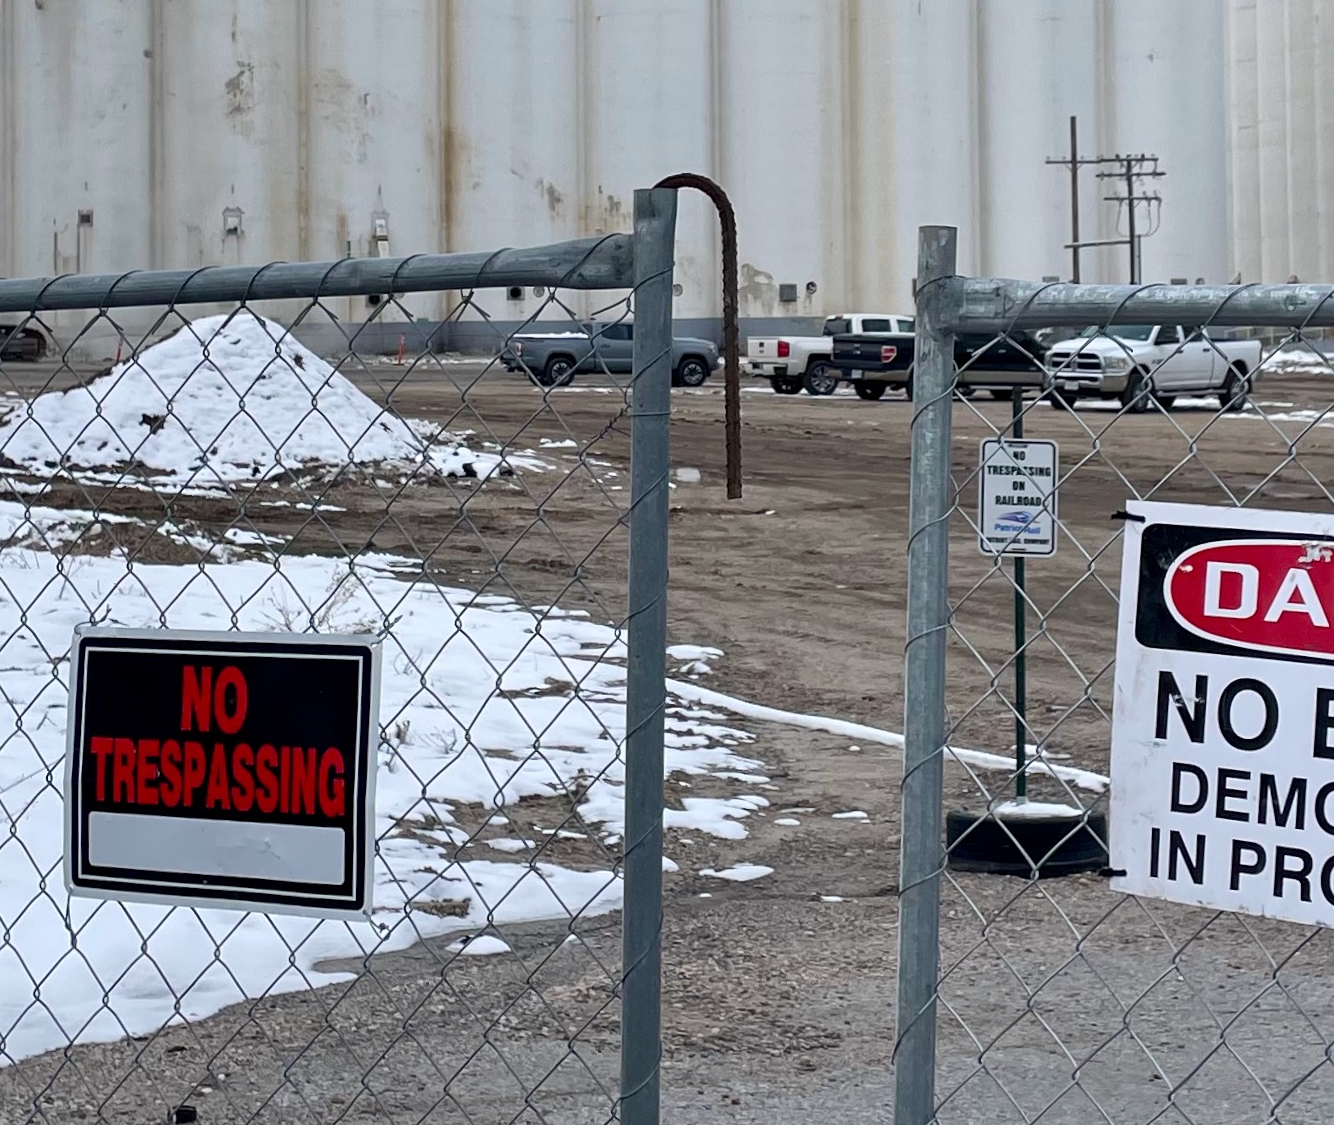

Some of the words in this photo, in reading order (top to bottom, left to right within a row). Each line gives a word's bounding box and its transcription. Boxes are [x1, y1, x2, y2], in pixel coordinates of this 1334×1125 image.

[1013, 450, 1026, 461] NO
[995, 495, 1042, 506] RAILROAD
[1012, 481, 1025, 491] ON
[181, 665, 248, 734] NO
[1155, 670, 1279, 751] NO
[91, 736, 345, 817] TRESPASSING
[1150, 827, 1206, 885] IN
